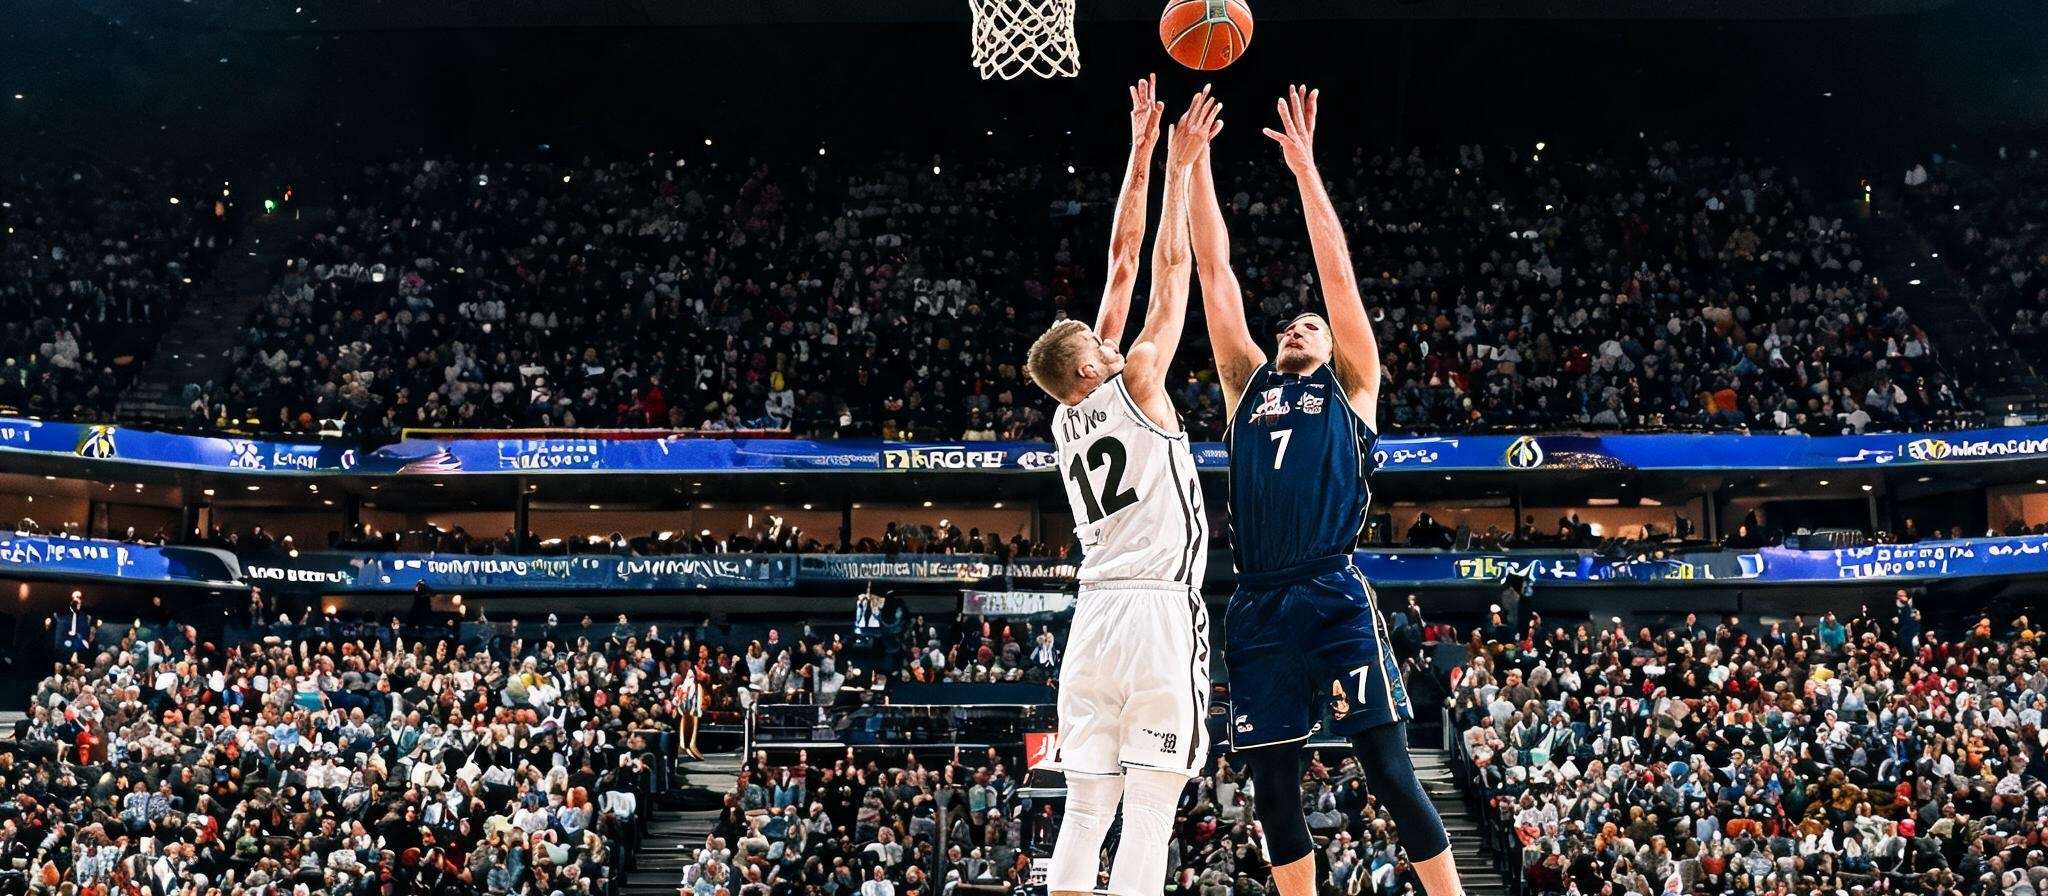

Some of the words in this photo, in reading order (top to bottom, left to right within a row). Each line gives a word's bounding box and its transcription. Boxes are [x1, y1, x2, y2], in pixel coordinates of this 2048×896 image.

[1270, 429, 1292, 469] 7
[1069, 436, 1140, 524] 12
[1350, 666, 1369, 704] 7
